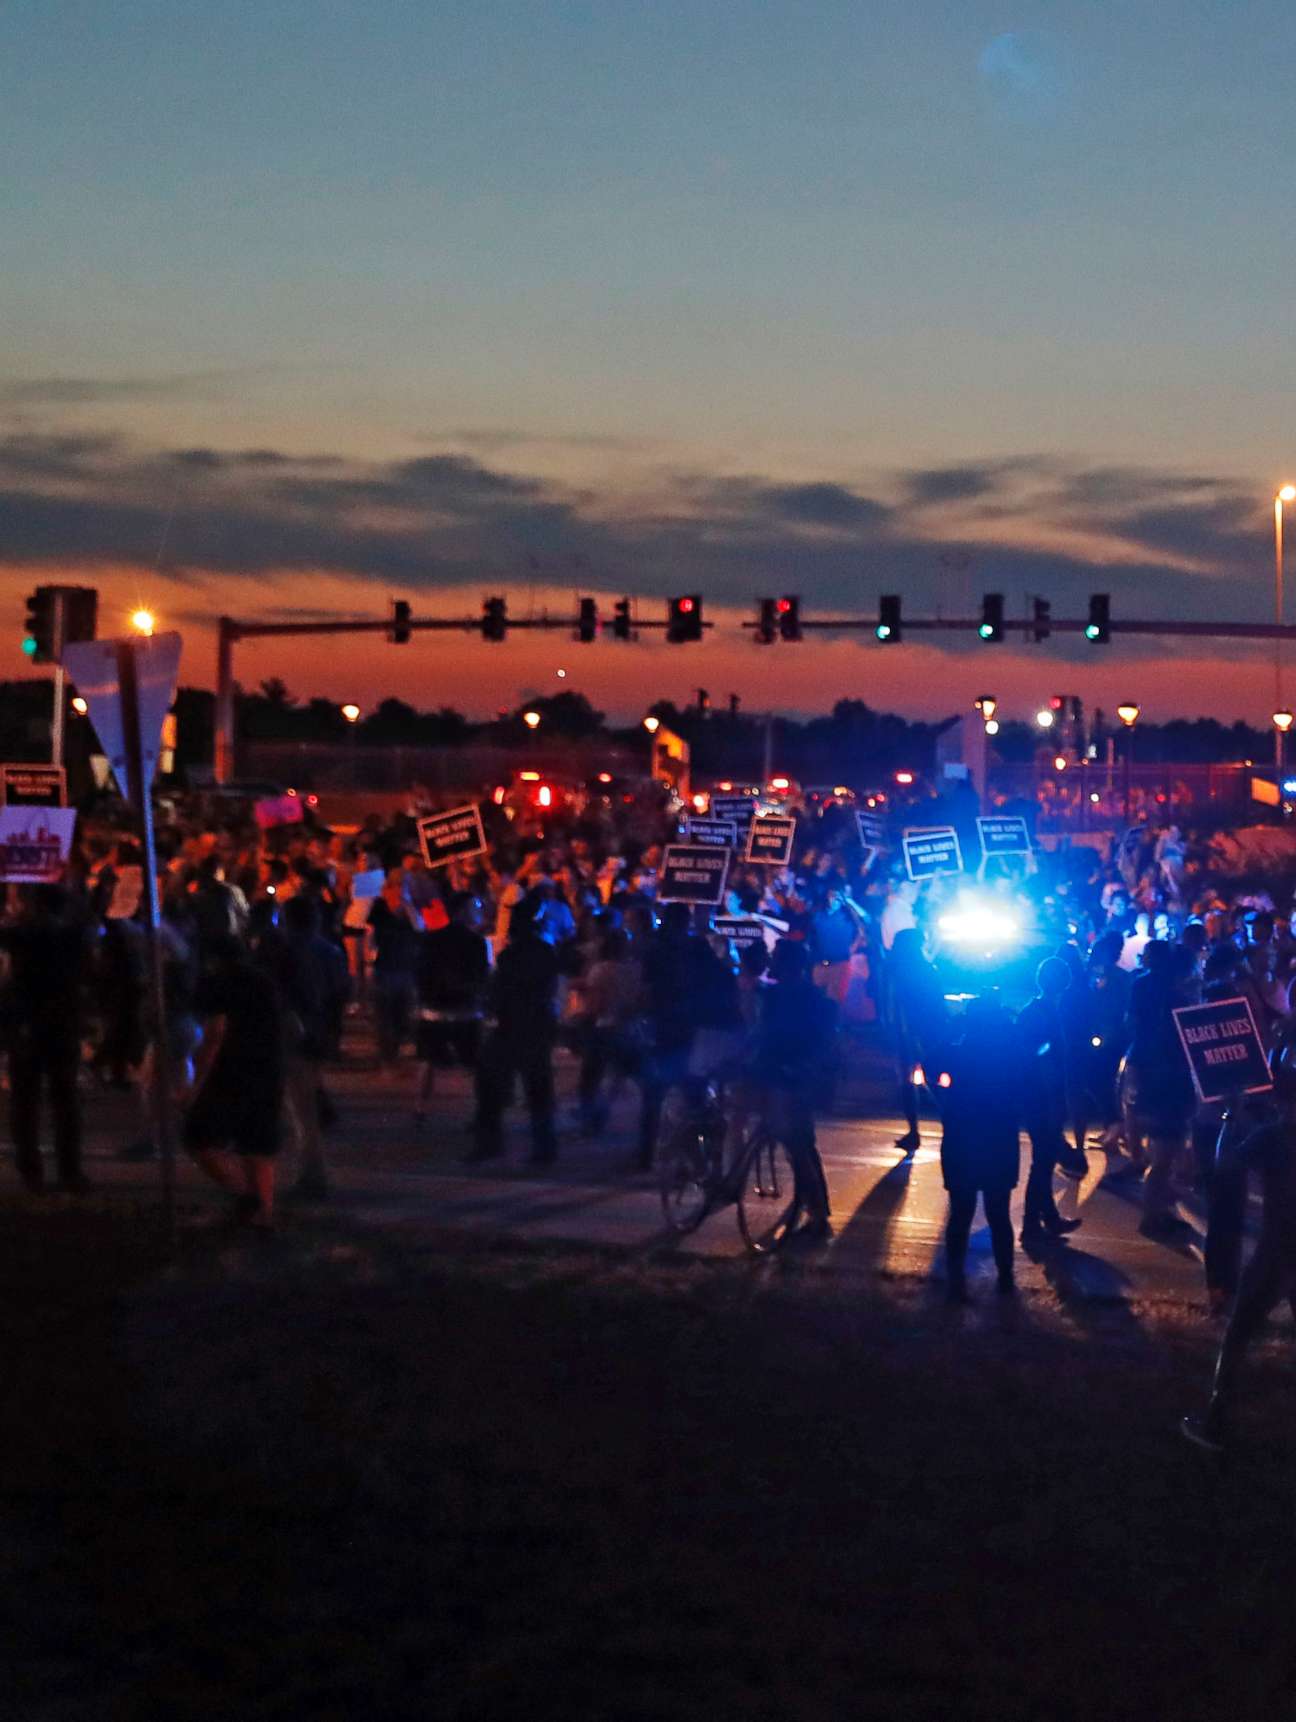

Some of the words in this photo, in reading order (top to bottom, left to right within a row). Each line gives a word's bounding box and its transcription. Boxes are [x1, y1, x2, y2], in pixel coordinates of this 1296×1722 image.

[1184, 1023, 1219, 1044] BLACK
[1218, 1018, 1252, 1038] LIVES
[1203, 1043, 1249, 1065] MATTER
